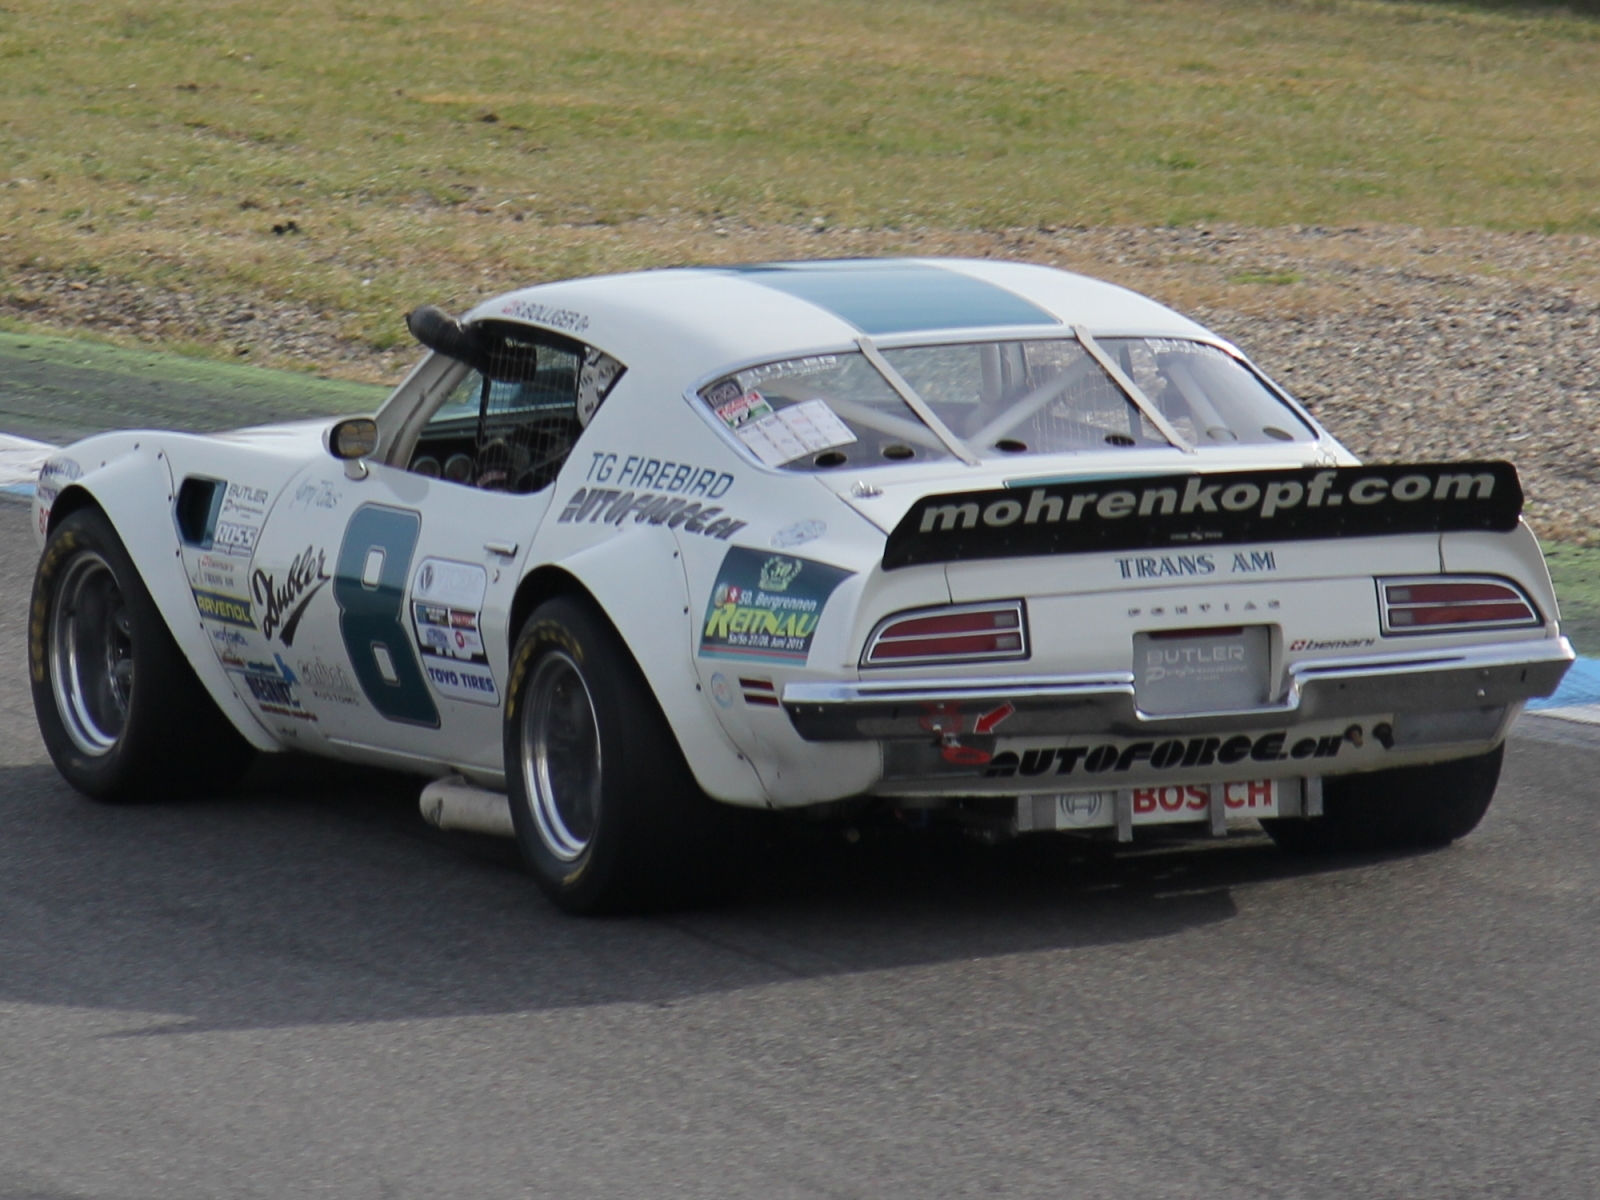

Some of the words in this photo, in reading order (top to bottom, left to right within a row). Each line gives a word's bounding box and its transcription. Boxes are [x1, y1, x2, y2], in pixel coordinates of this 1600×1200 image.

[586, 453, 618, 482] TG
[617, 455, 735, 500] FIREBIRD
[228, 483, 269, 505] BUTLER
[919, 471, 1496, 533] mohrenkopf.com
[215, 521, 259, 547] ROSS
[1115, 553, 1216, 579] TRANS
[1231, 551, 1277, 572] AM
[755, 591, 818, 612] Bergrennen
[1127, 600, 1281, 617] PONTIAC
[333, 502, 441, 729] 8
[1146, 645, 1244, 665] BUTLER
[428, 666, 459, 687] TOYO
[460, 673, 495, 693] TIRES
[1132, 778, 1273, 815] BOSCH
